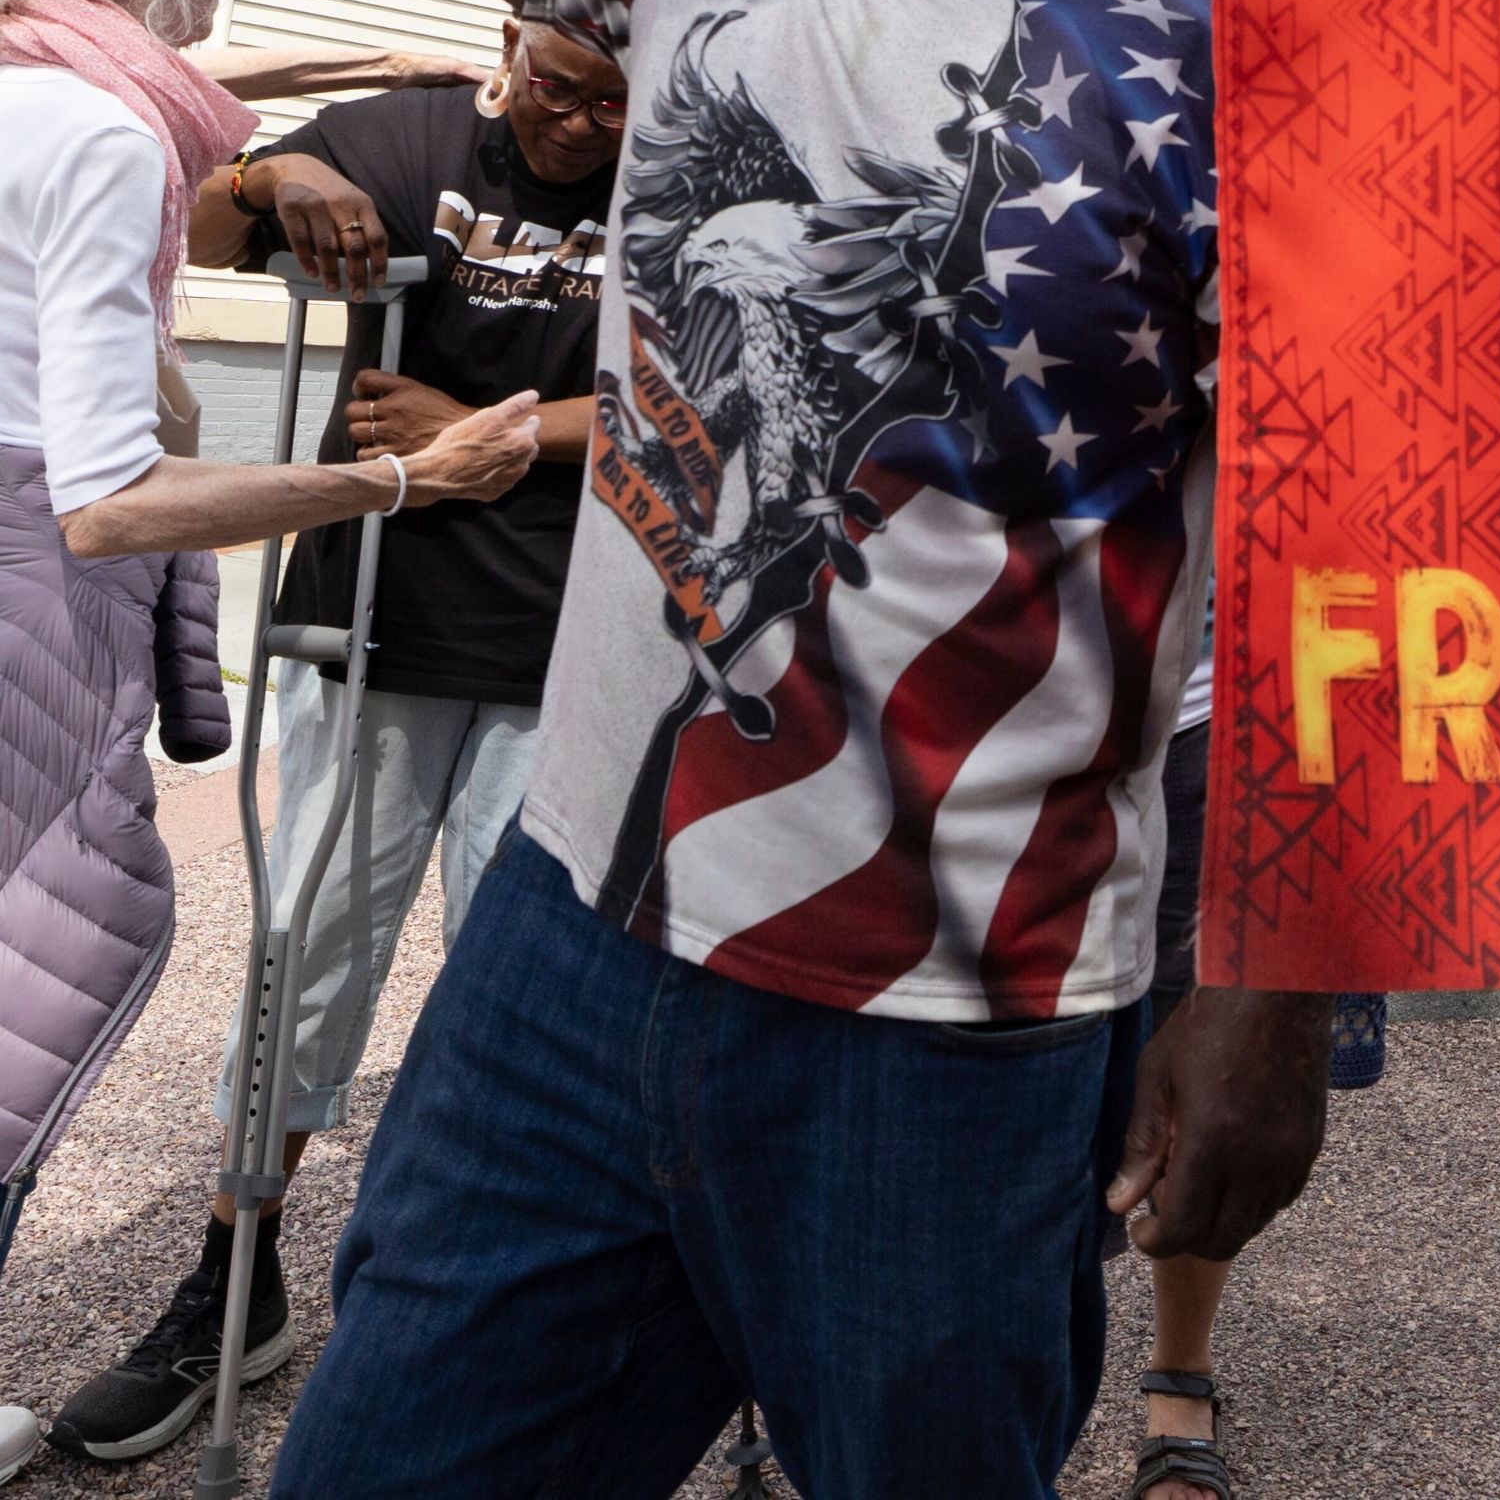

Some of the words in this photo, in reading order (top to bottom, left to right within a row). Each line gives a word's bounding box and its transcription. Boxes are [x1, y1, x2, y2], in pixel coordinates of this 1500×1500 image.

[468, 295, 483, 306] of
[482, 298, 507, 309] New
[636, 364, 676, 409] LIVE
[662, 407, 691, 438] TO
[627, 488, 650, 523] TO
